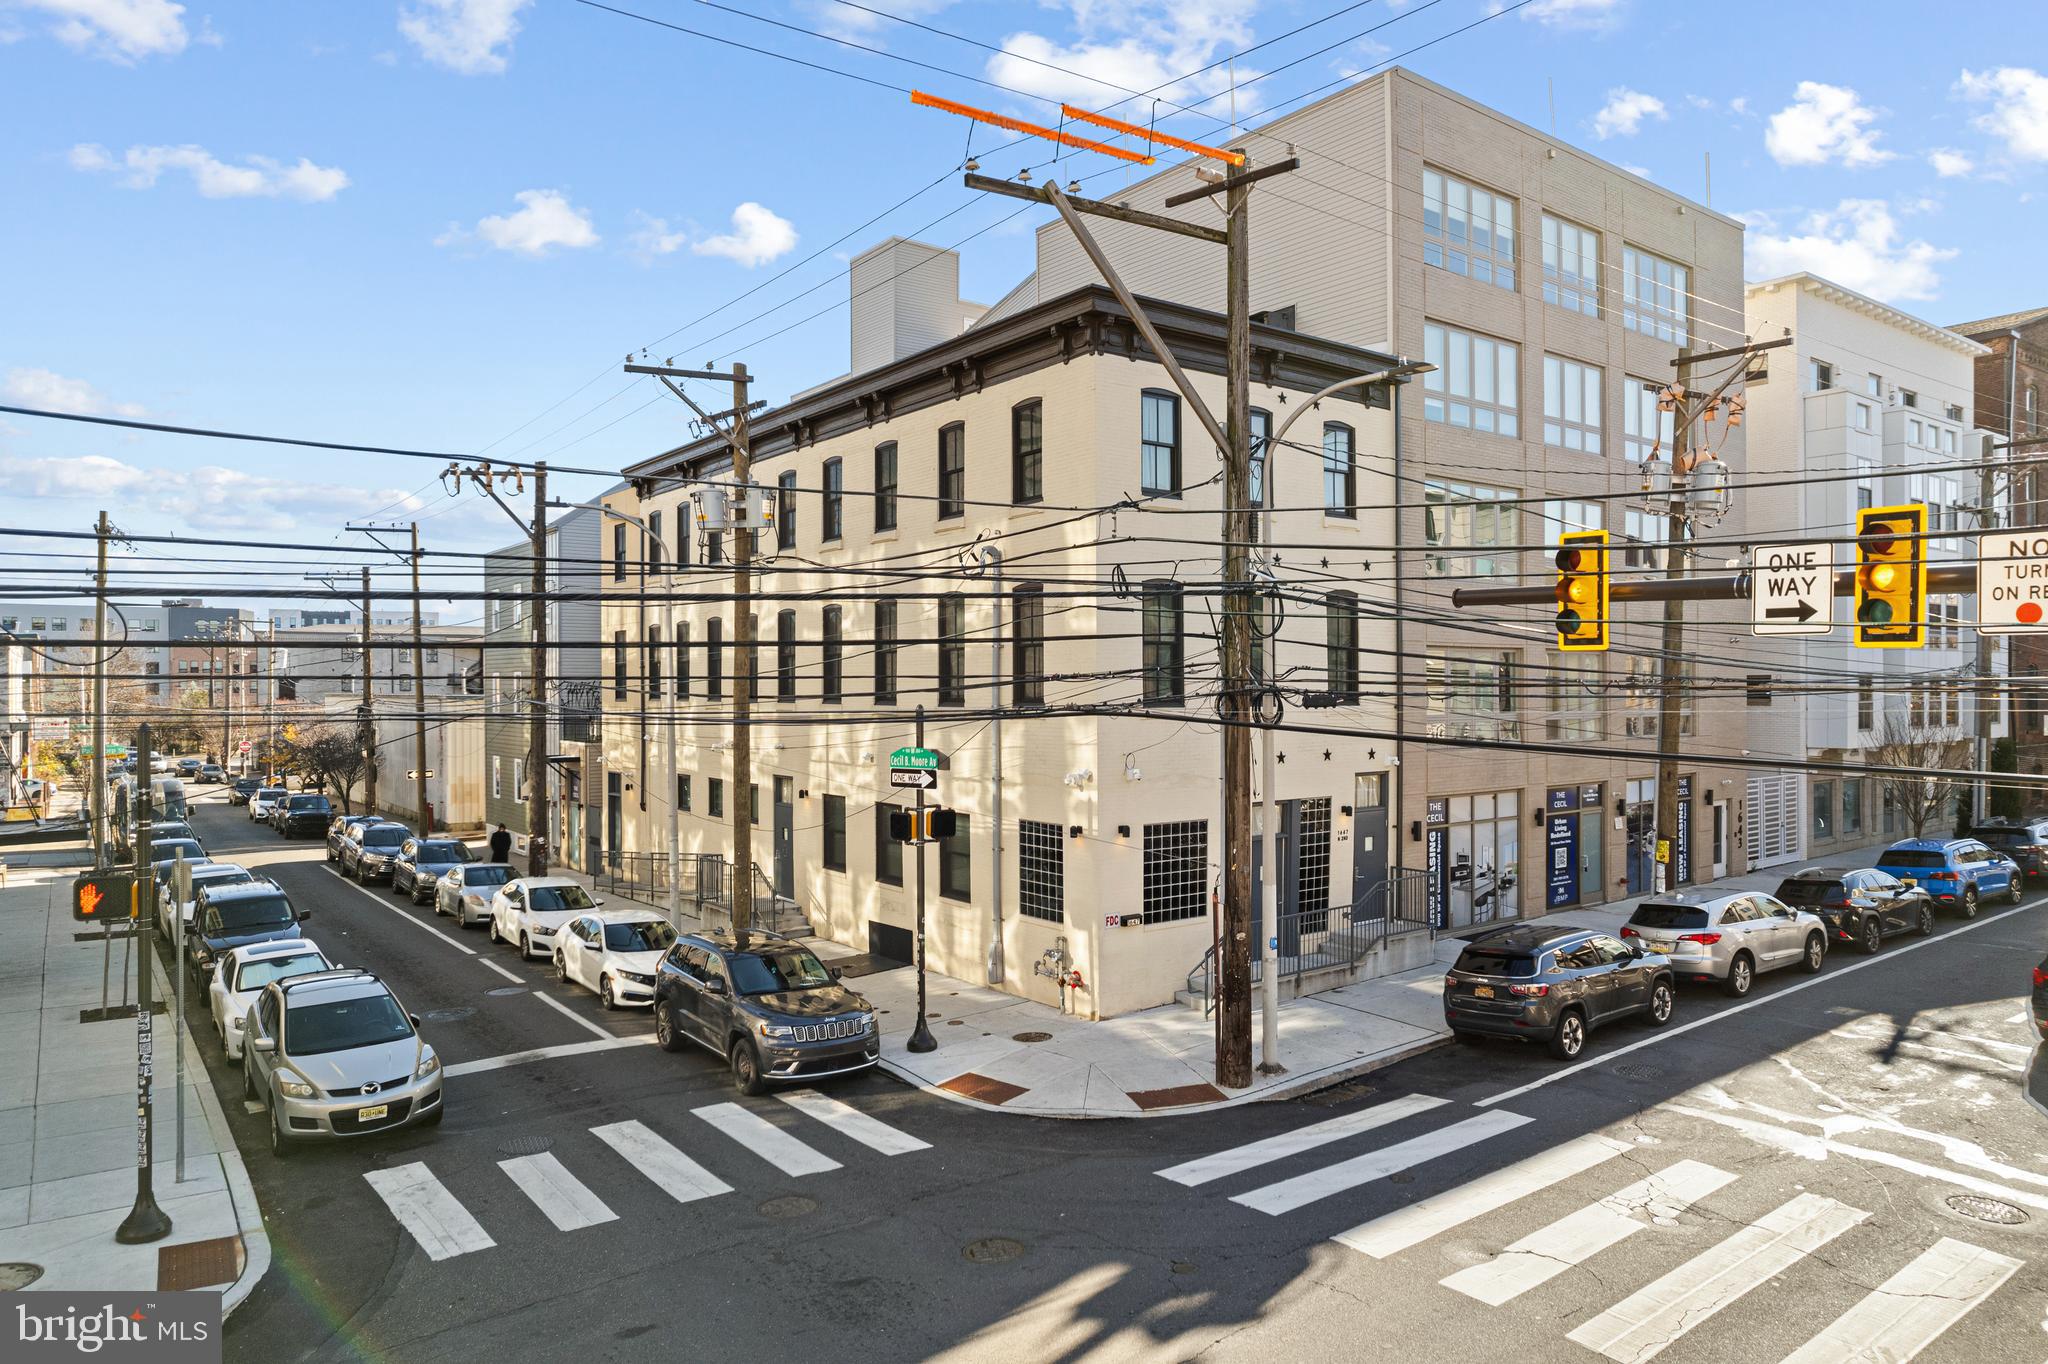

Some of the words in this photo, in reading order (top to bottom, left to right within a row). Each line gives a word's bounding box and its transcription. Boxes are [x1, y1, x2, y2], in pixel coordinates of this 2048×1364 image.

[2009, 538, 2048, 557] NO
[1769, 551, 1817, 573] ONE
[2003, 563, 2048, 580] TUR
[1768, 576, 1817, 597] WAY
[1992, 586, 2019, 601] ON
[890, 755, 904, 766] Cecil
[904, 757, 910, 766] B.
[911, 756, 928, 767] Moore
[929, 757, 937, 767] Av
[893, 773, 905, 782] ONE
[907, 774, 920, 782] WAY
[1556, 791, 1566, 799] THE
[1429, 802, 1442, 811] THE
[1554, 800, 1568, 808] CECIL
[1426, 814, 1445, 823] CECIL
[1105, 914, 1119, 927] FDC
